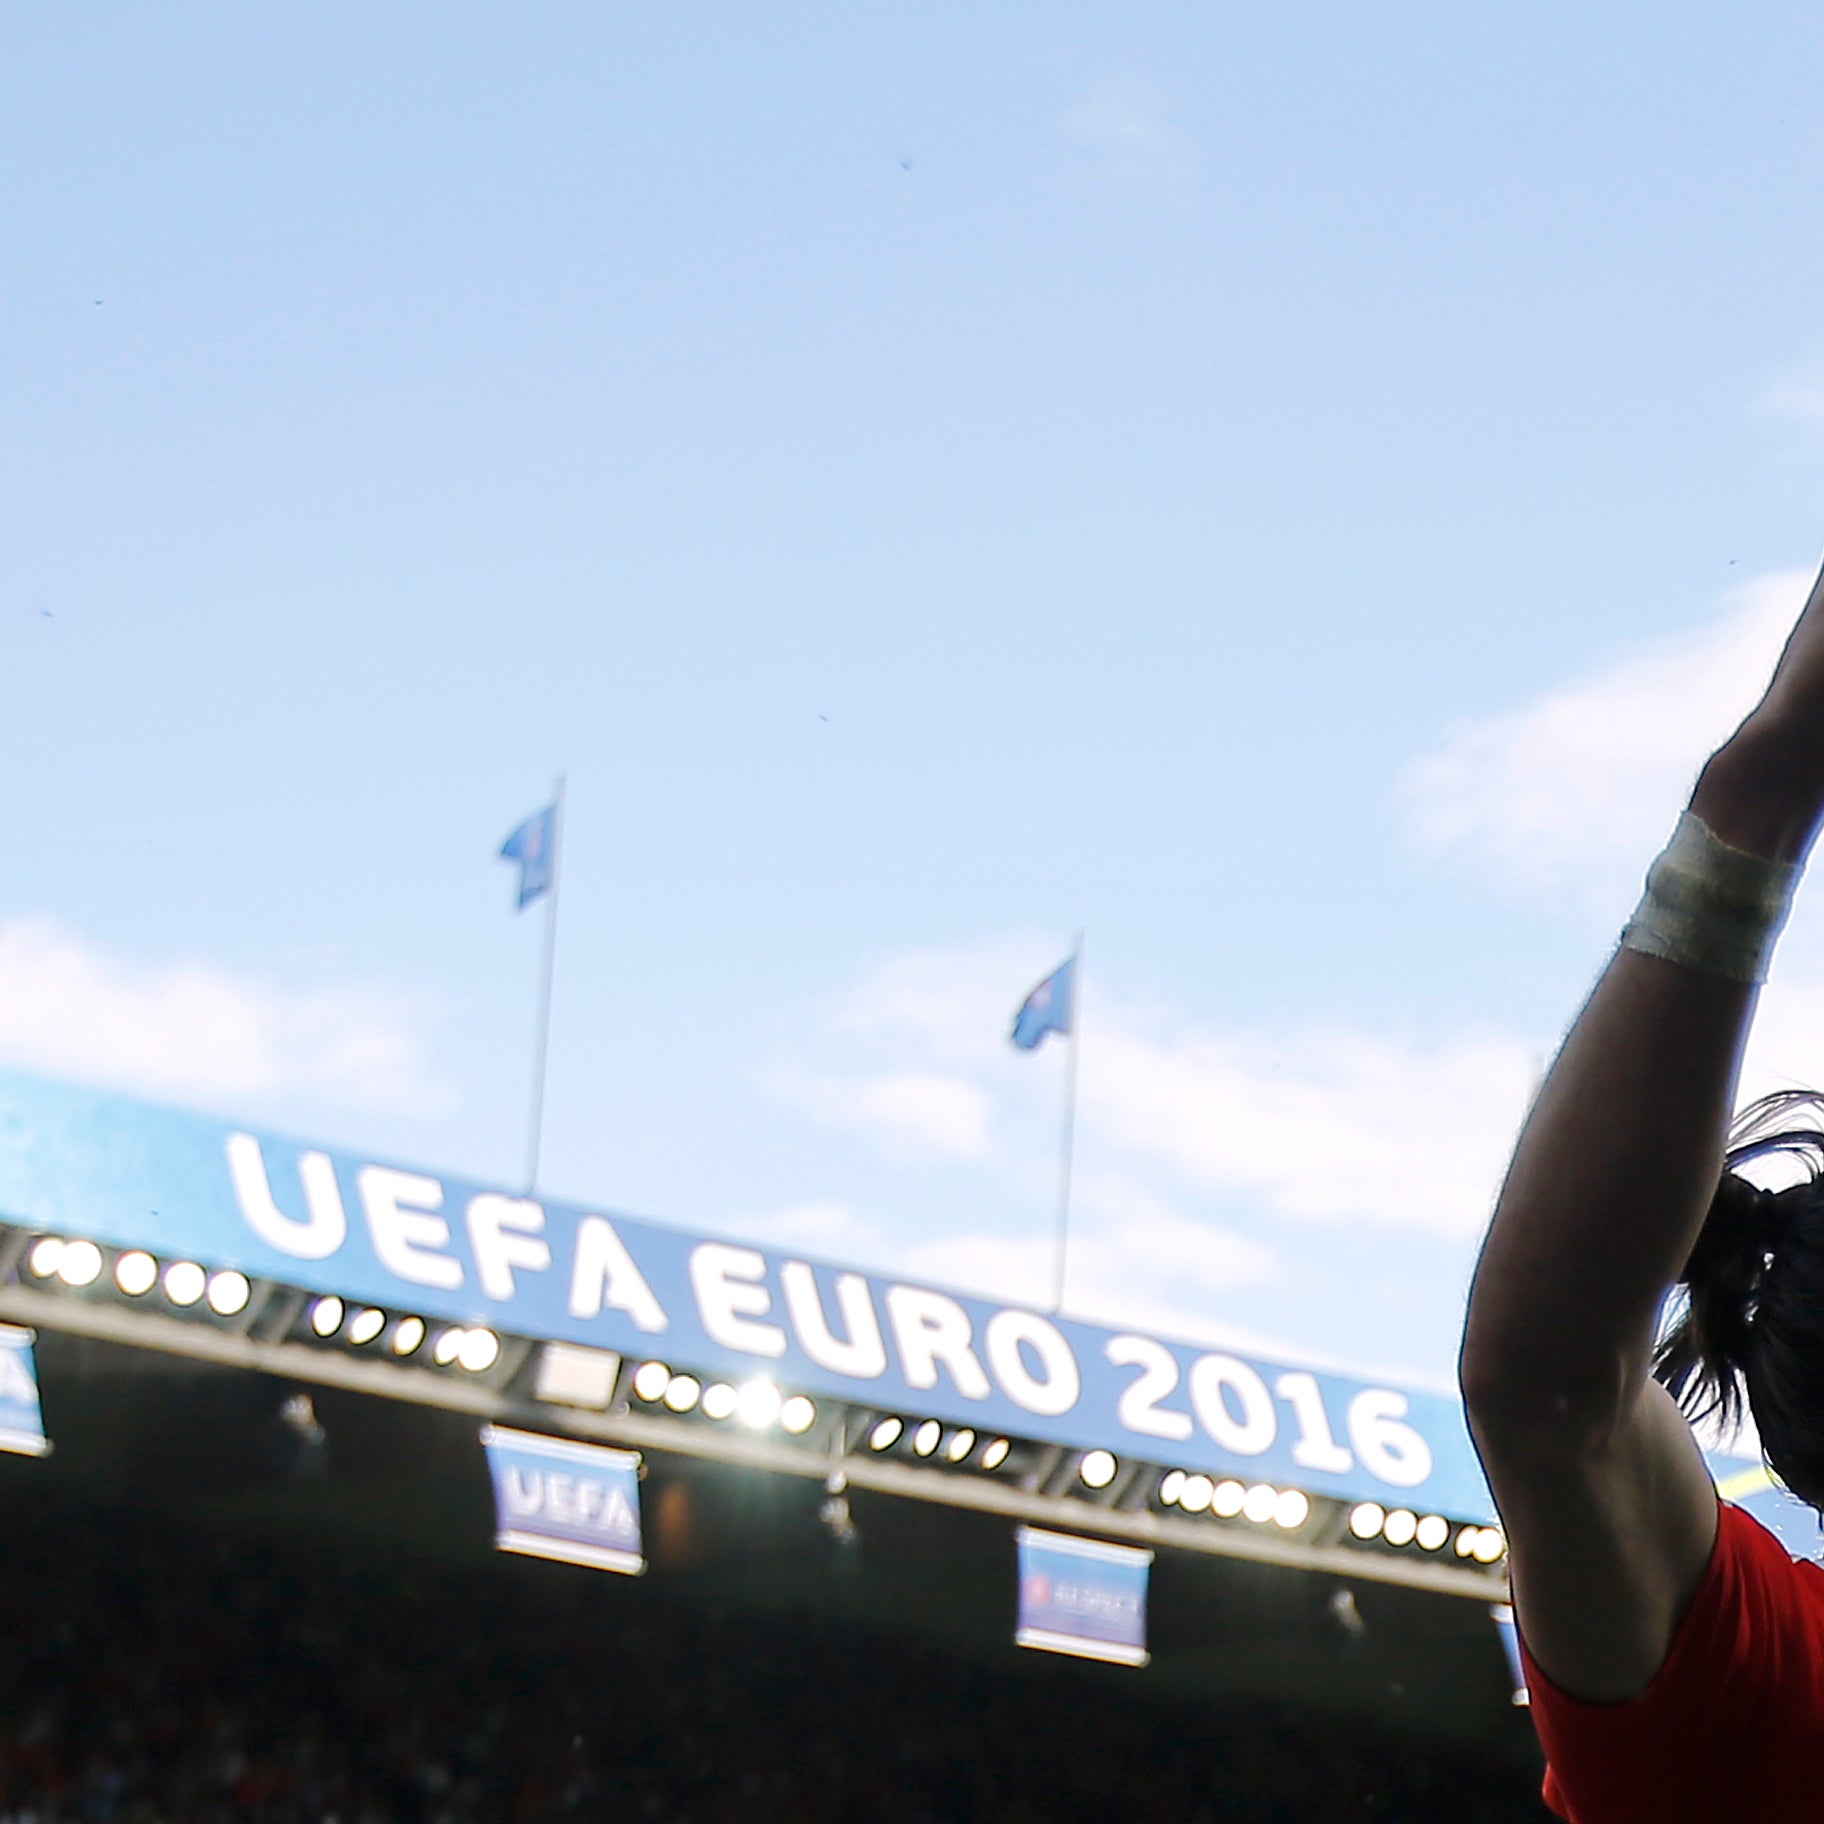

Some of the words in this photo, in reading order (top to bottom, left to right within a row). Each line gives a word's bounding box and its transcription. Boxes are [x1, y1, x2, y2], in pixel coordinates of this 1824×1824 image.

[226, 1131, 668, 1334] UEFA
[688, 1240, 1080, 1417] EURO
[1103, 1333, 1434, 1488] 2016
[504, 1462, 639, 1535] UEFA
